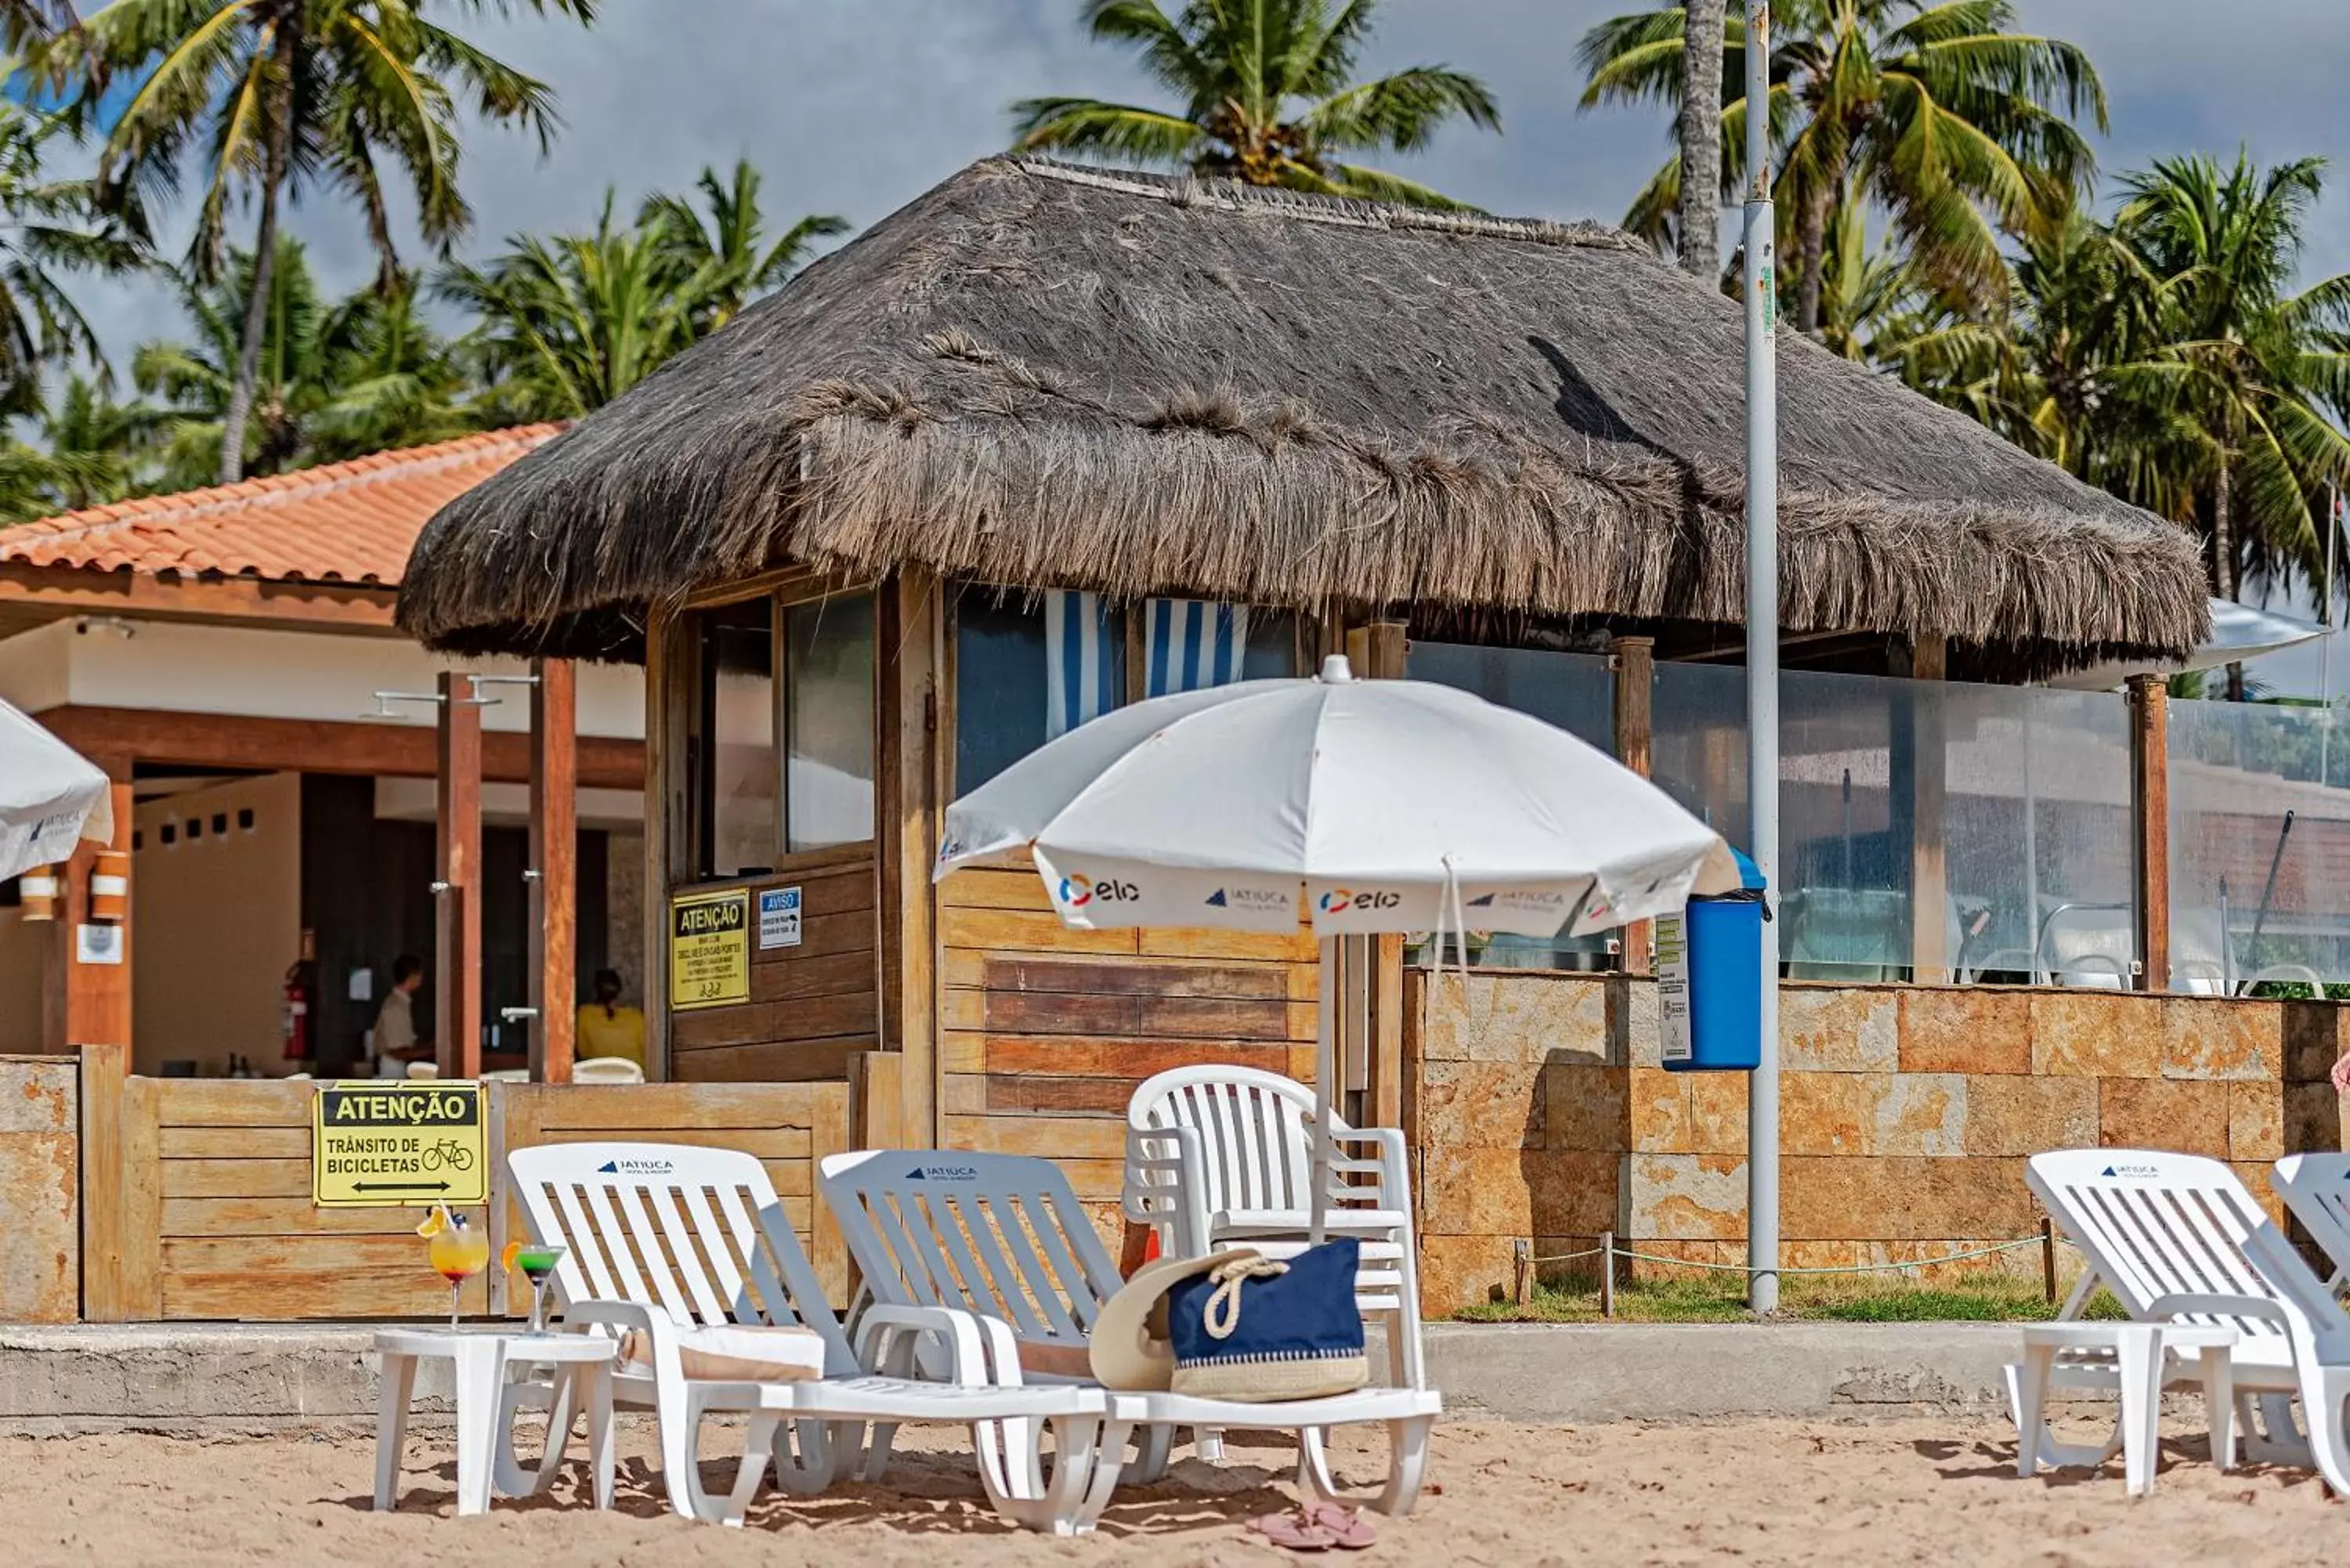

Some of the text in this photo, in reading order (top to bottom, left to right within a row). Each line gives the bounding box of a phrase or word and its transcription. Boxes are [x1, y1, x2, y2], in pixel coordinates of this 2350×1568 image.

[1095, 879, 1139, 901] elo
[1354, 891, 1401, 909] elo
[681, 902, 739, 930] ATENÇÃO
[336, 1092, 465, 1124] ATENÇÃO
[327, 1136, 419, 1153] TRÂNSITO DE
[327, 1158, 419, 1173] BICICLETAS
